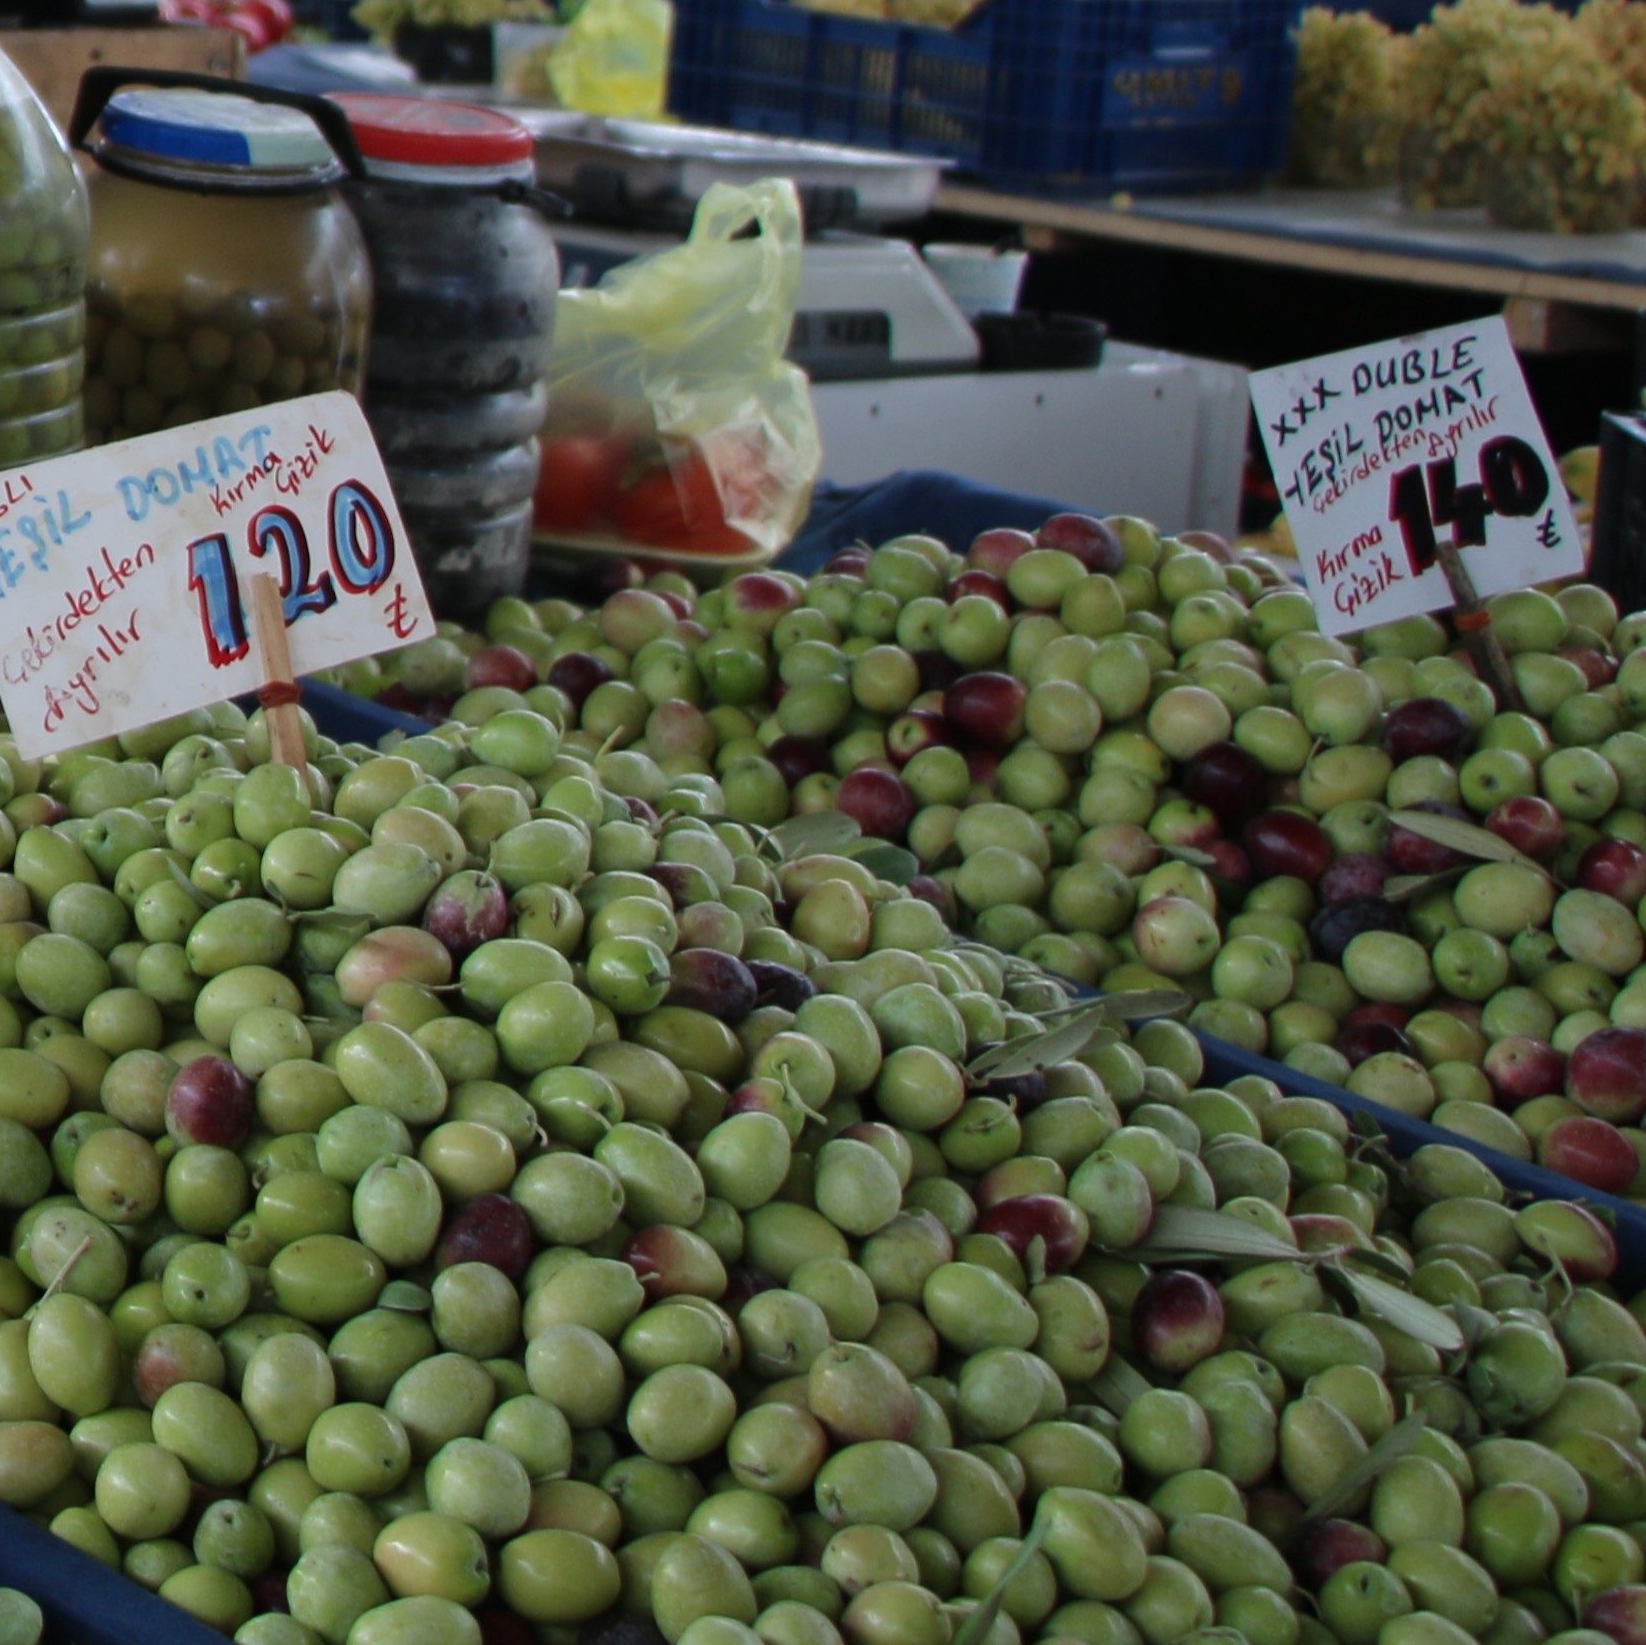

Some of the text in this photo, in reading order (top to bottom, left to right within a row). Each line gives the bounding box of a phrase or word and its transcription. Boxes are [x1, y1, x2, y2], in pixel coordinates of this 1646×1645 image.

[1352, 335, 1477, 397] DUBLE
[1372, 368, 1485, 446] DOMAT
[115, 424, 273, 523] DOMAT
[1388, 434, 1551, 579] 140
[186, 478, 396, 669] 120
